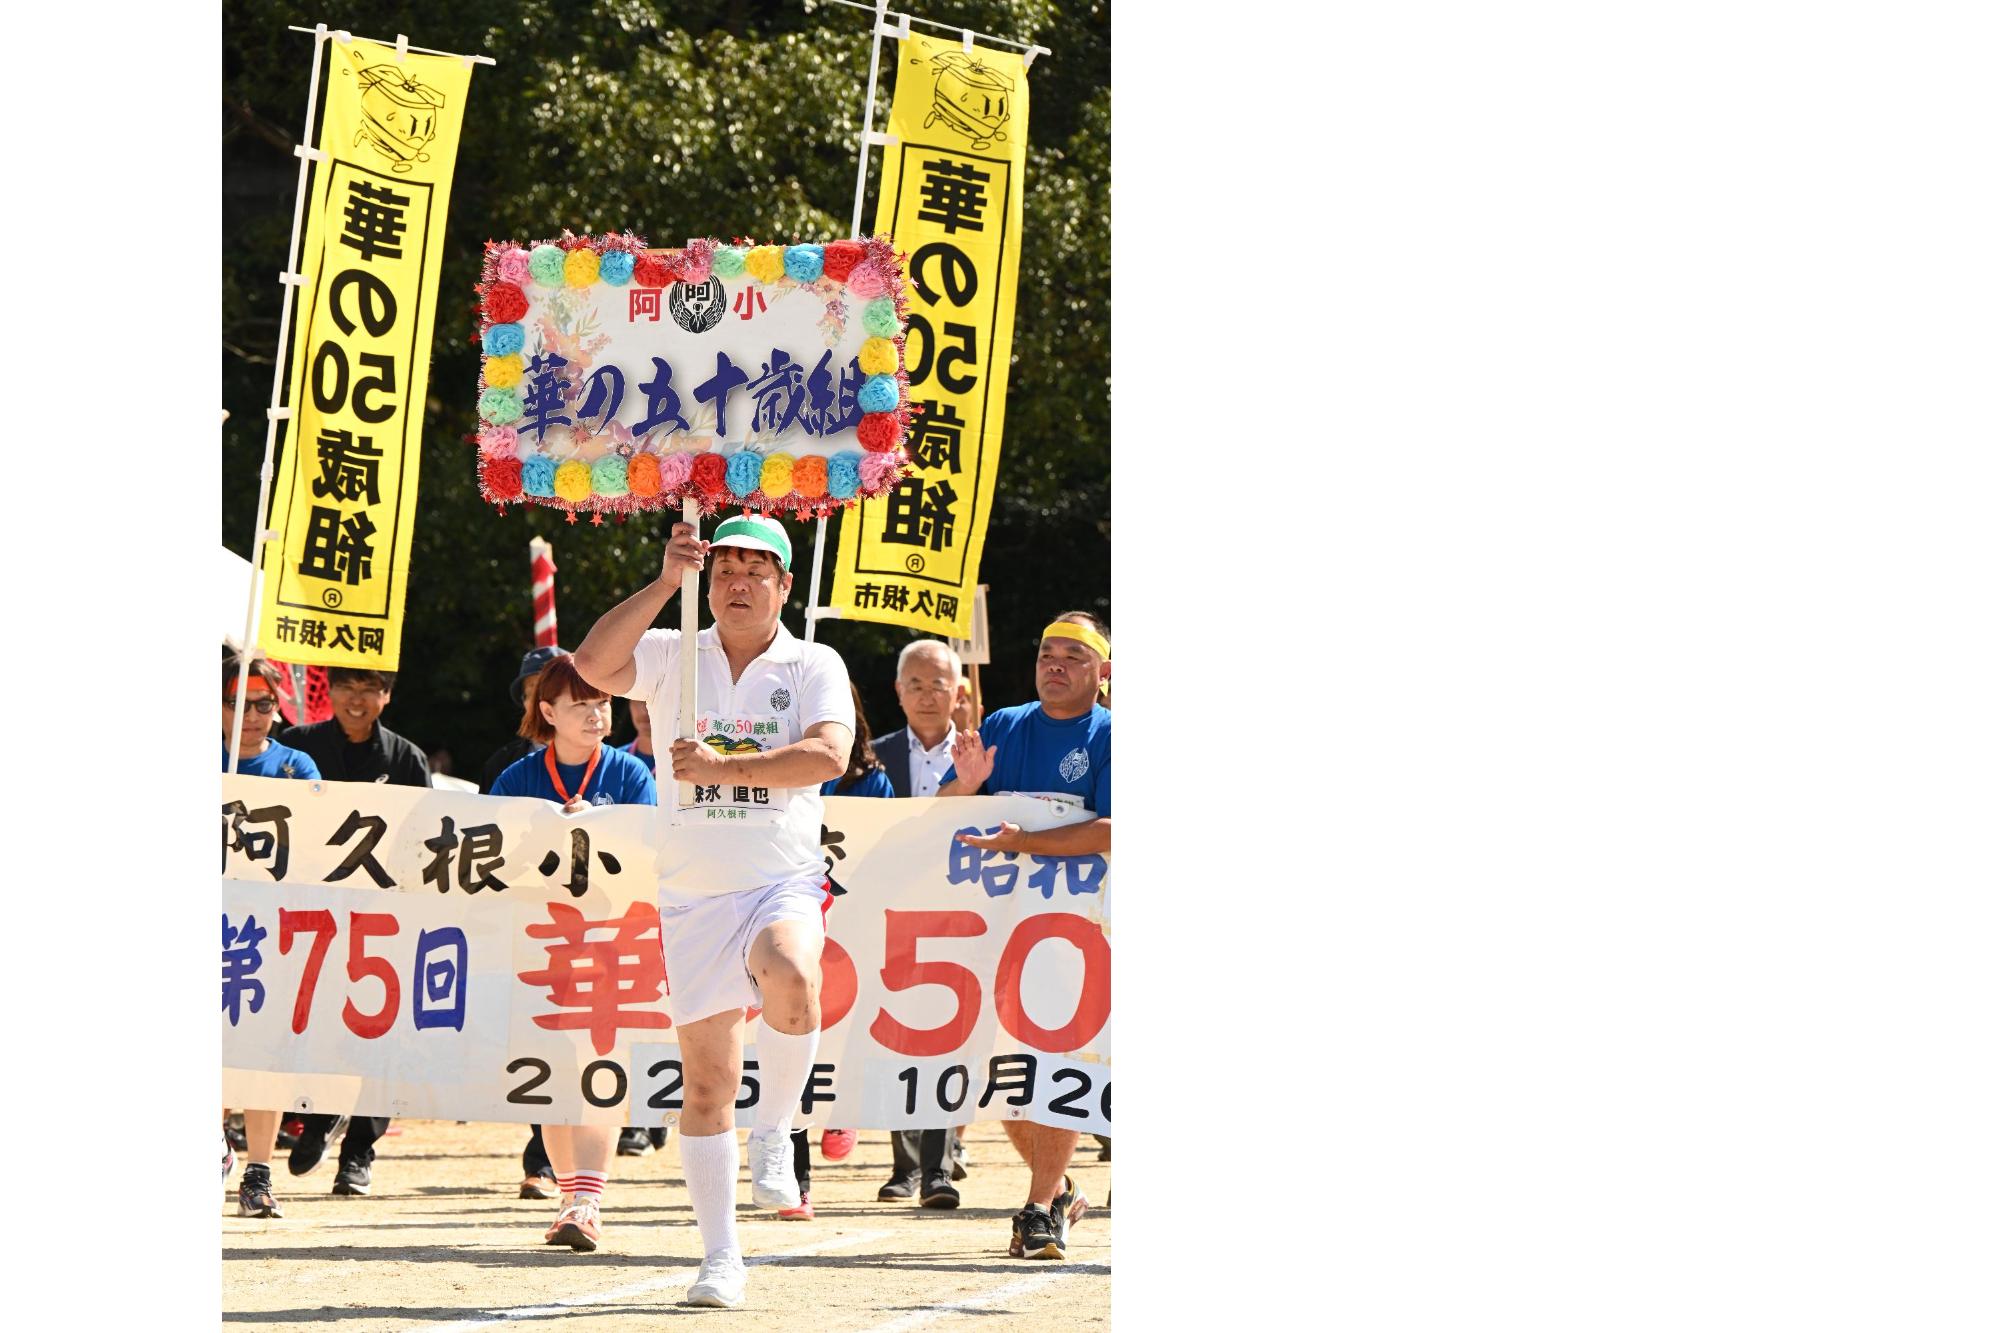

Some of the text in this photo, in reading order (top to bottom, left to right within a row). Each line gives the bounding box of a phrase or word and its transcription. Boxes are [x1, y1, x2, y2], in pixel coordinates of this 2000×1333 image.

[629, 286, 768, 322] 阿 小
[517, 348, 867, 444] 華の五十歳組
[707, 809, 747, 819] 阿久根市
[222, 906, 468, 1040] 第75回
